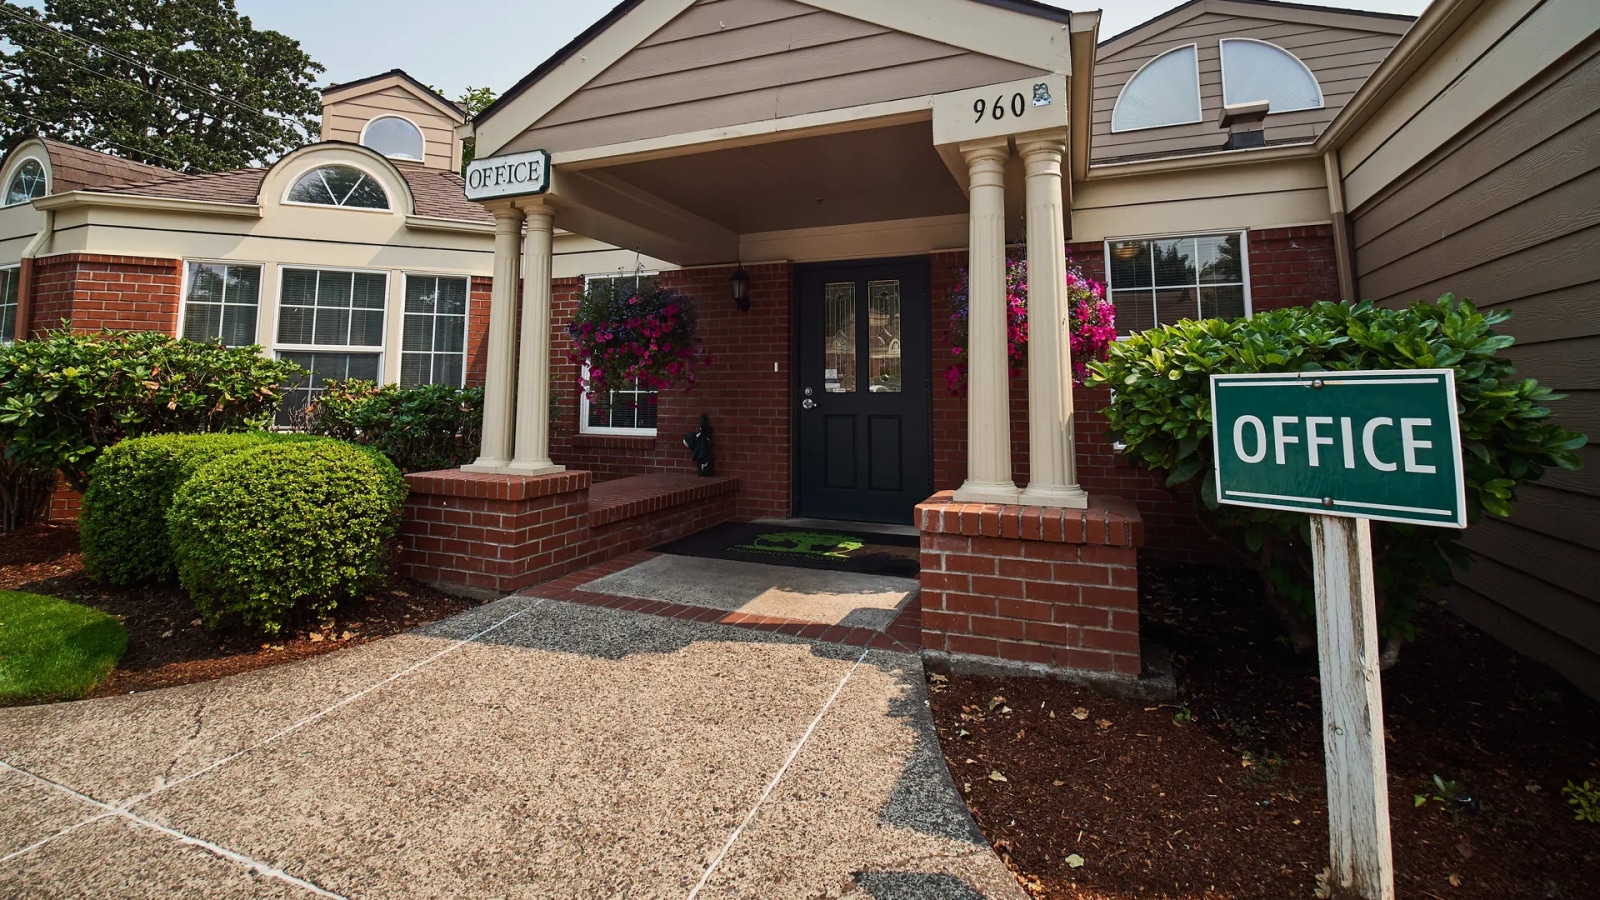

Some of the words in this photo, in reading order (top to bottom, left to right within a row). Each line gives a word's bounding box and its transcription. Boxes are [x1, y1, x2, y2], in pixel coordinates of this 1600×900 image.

[973, 92, 1025, 123] 960
[469, 160, 540, 189] OFFICE
[1233, 414, 1437, 474] OFFICE
